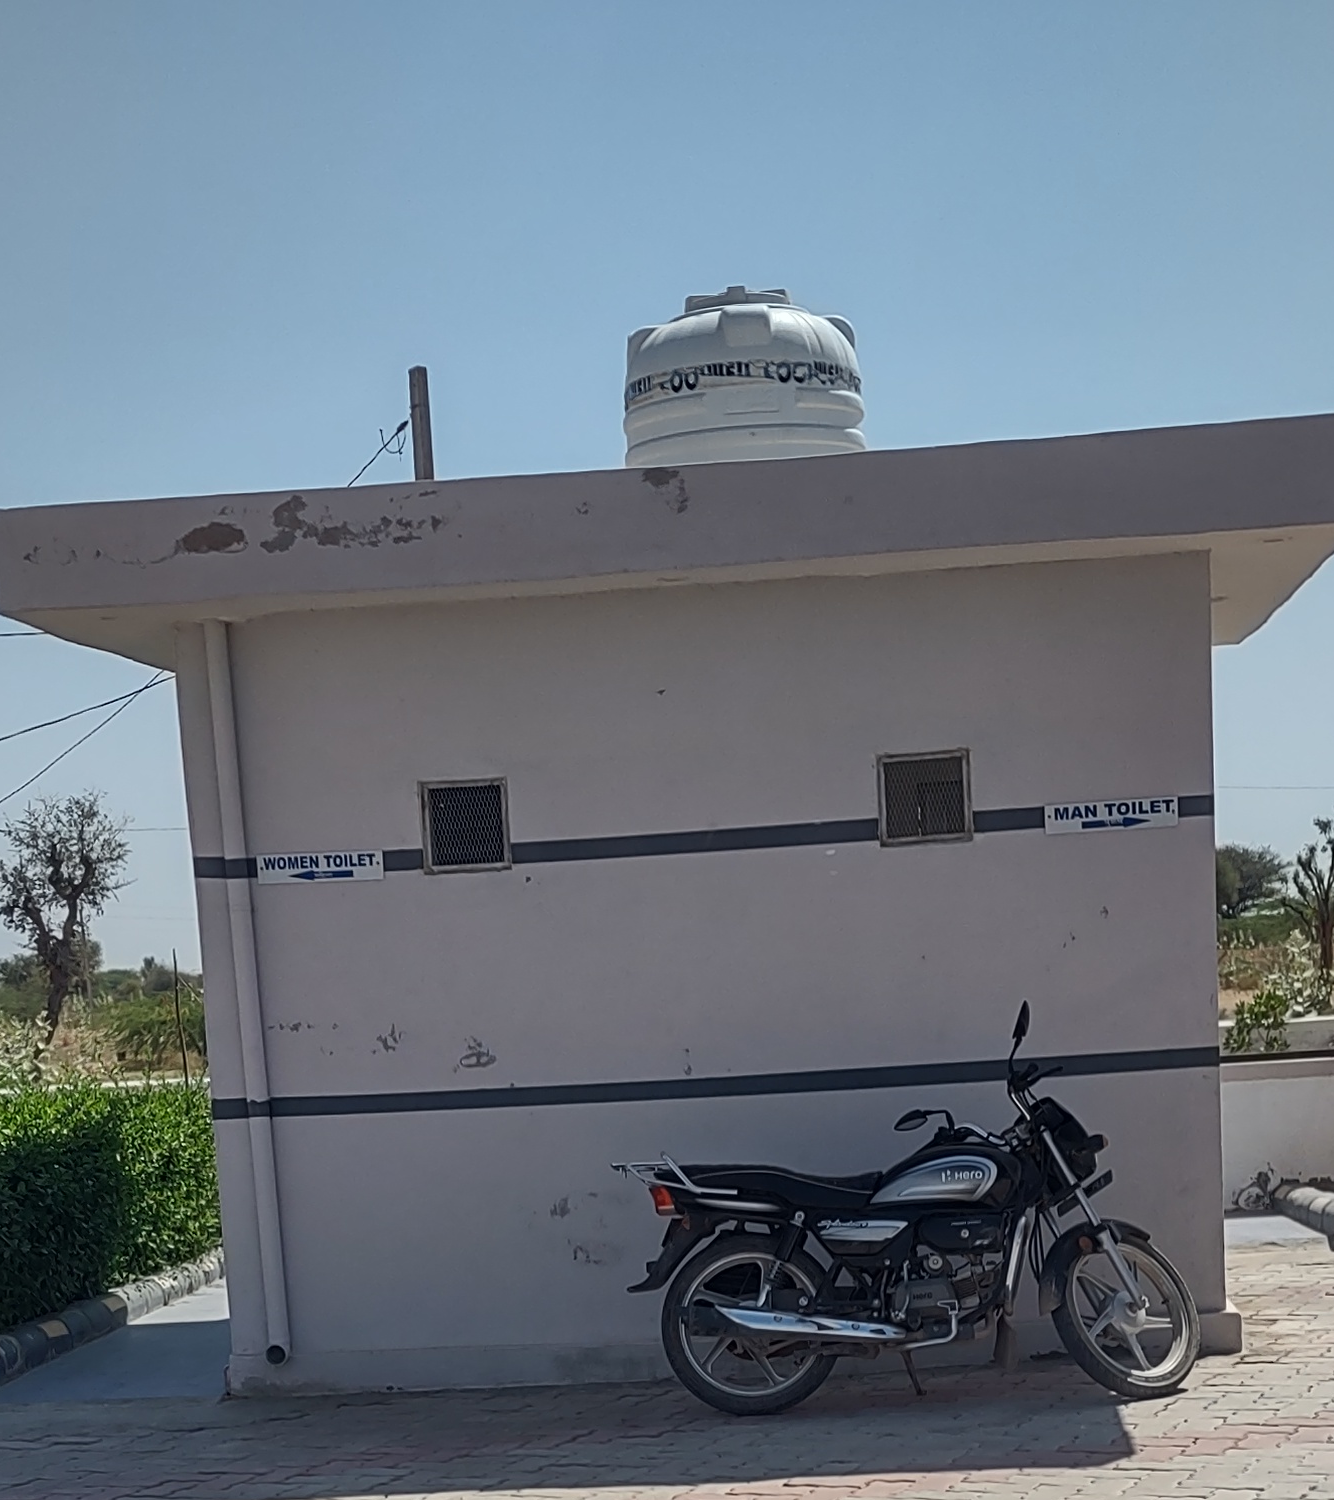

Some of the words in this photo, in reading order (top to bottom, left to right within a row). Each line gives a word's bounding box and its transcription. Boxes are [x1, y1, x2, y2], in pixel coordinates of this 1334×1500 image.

[1054, 804, 1098, 821] MAN
[1104, 799, 1175, 816] TOILET
[263, 855, 320, 870] WOMEN
[323, 853, 376, 868] TOILET
[954, 1170, 983, 1180] Hero
